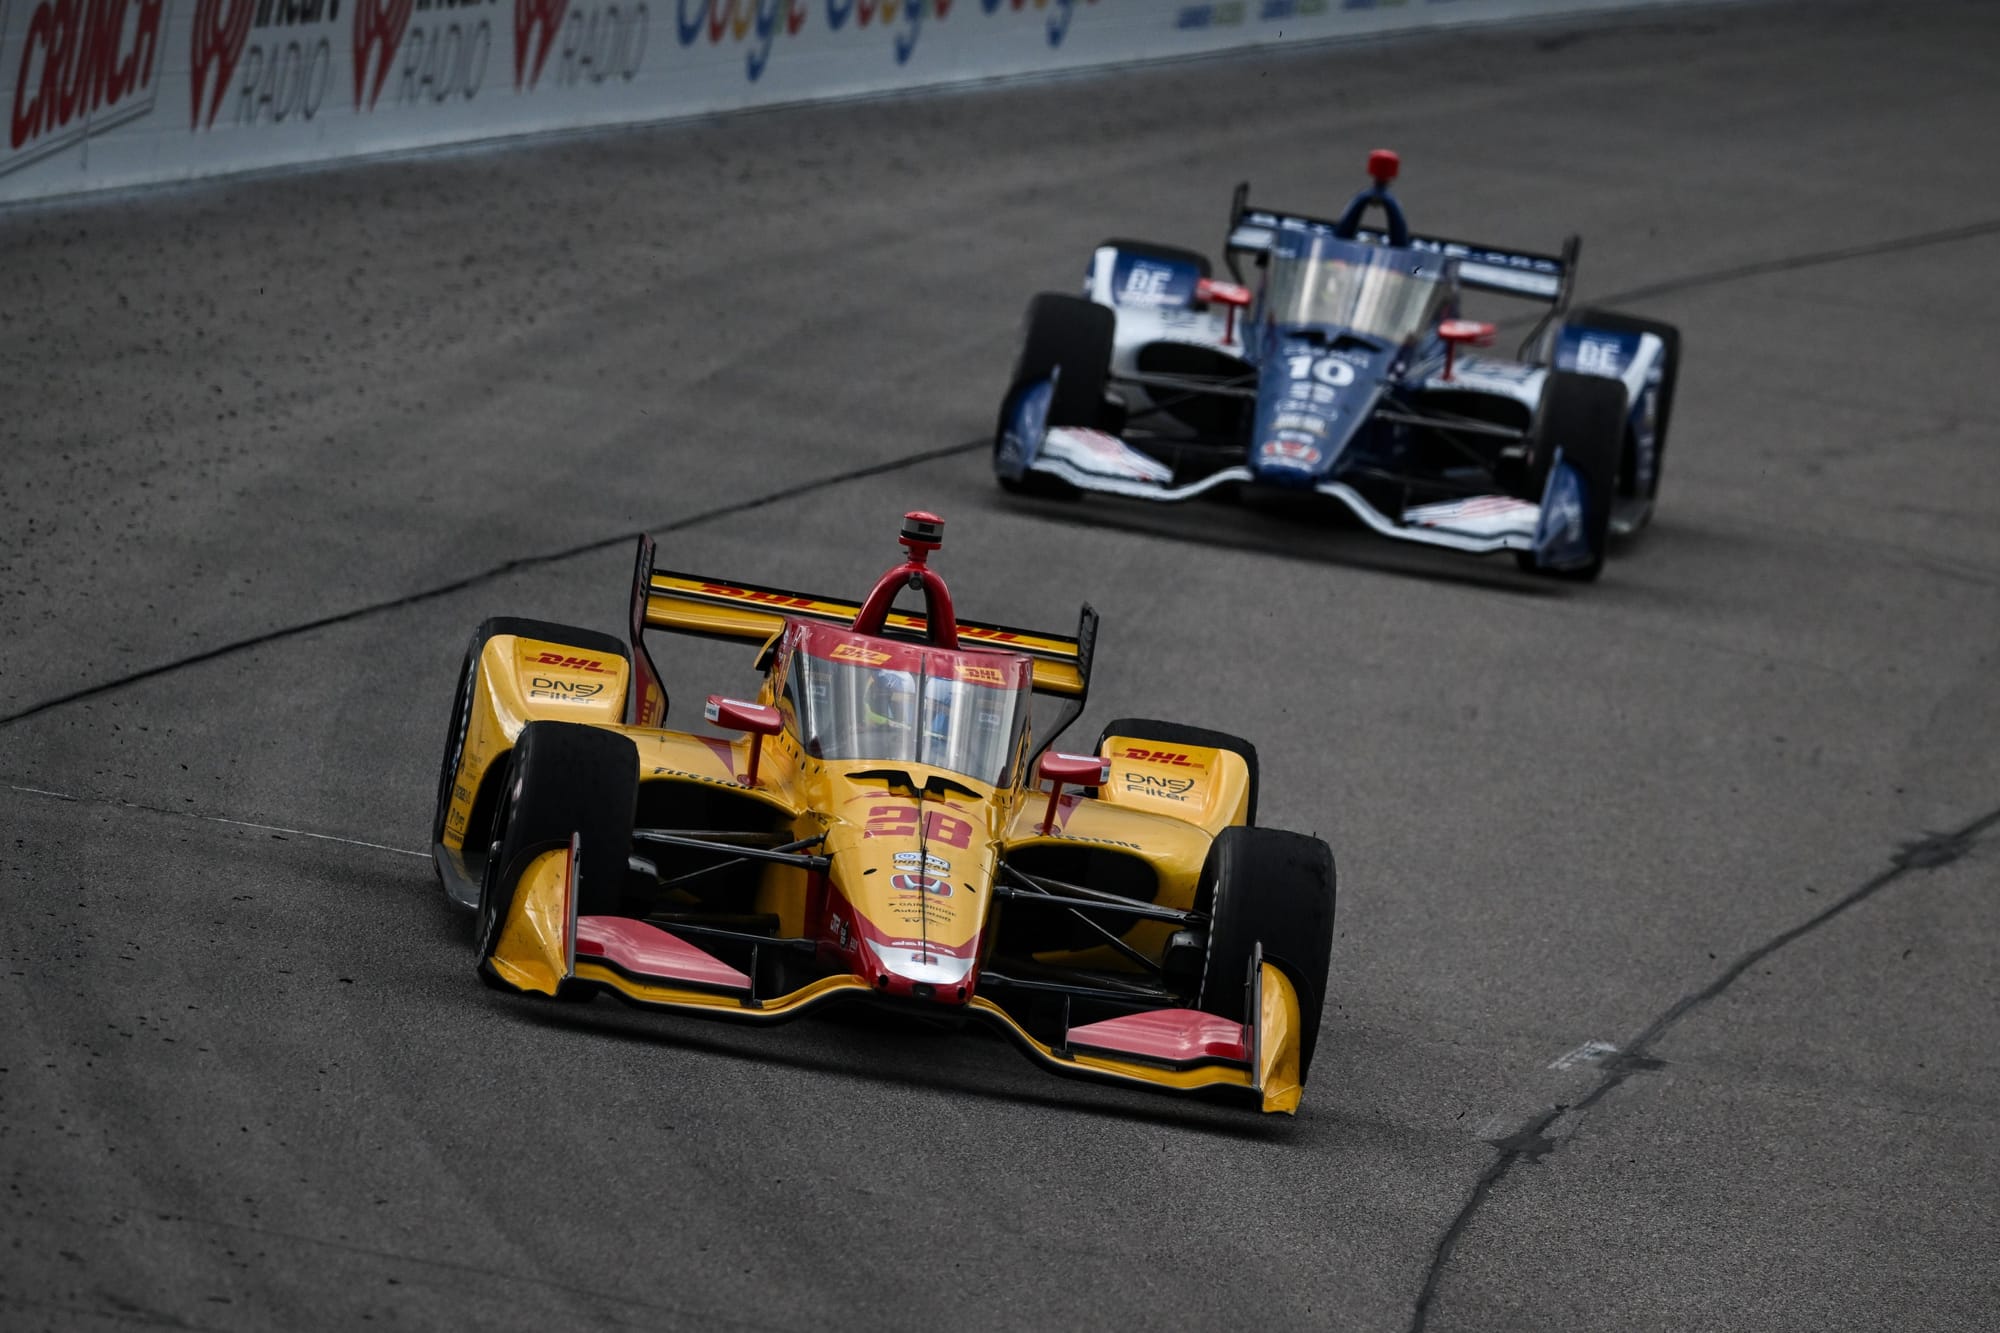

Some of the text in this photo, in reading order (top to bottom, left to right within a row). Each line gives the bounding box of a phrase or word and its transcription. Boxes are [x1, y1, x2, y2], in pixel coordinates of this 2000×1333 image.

[556, 2, 650, 87] RADIO
[399, 18, 491, 103] RADIO
[234, 37, 331, 125] RADIO
[1287, 354, 1356, 387] 10
[700, 582, 819, 612] DHL
[537, 652, 605, 673] DHL
[839, 646, 880, 661] DHL
[965, 667, 1000, 681] DHL
[530, 689, 597, 704] Filter
[532, 677, 604, 697] DNS
[1125, 747, 1192, 767] DHL
[1125, 772, 1195, 794] DNS
[1126, 784, 1189, 802] Filter
[863, 805, 973, 850] 28
